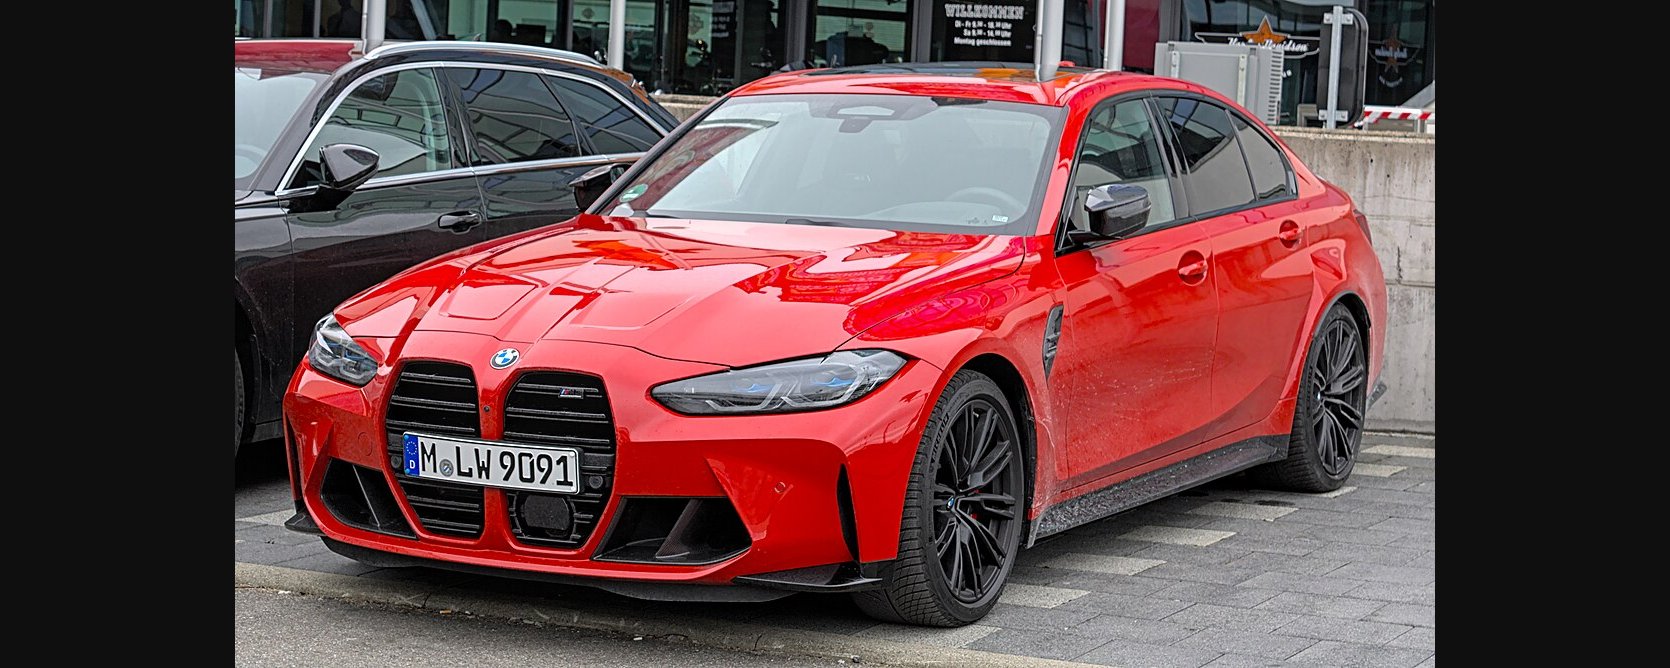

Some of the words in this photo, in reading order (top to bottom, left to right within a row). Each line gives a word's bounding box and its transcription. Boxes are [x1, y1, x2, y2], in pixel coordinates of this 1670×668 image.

[945, 4, 1024, 19] WILLKOMMEN
[1001, 30, 1012, 38] Uhr
[954, 37, 975, 46] Montag
[410, 459, 416, 469] D
[420, 441, 437, 473] M
[455, 446, 491, 480] LW
[499, 451, 574, 486] 9091
